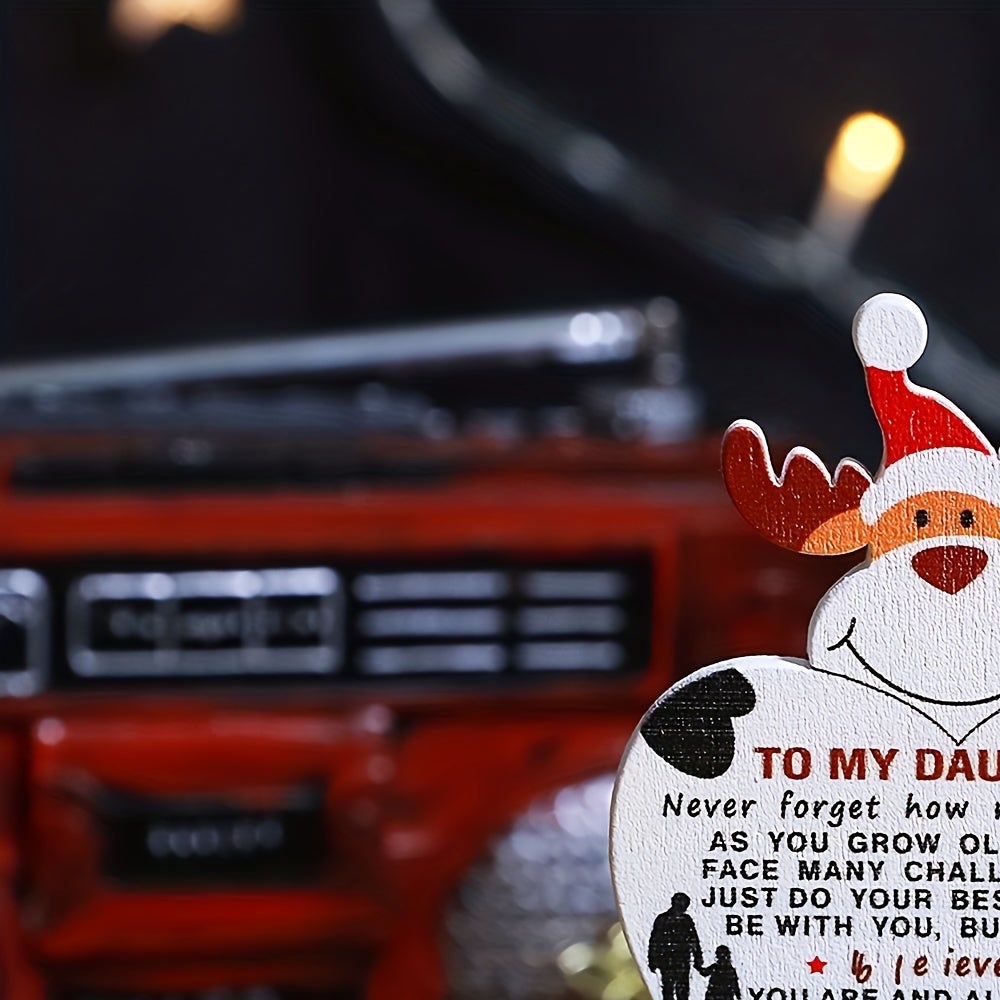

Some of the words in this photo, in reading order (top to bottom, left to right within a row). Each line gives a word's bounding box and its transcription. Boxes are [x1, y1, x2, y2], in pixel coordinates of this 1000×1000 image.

[755, 747, 811, 780] TO
[829, 748, 899, 780] MY
[662, 792, 756, 817] Never
[780, 789, 880, 827] forget
[905, 793, 969, 820] how
[709, 831, 748, 852] AS
[768, 832, 828, 852] YOU
[847, 832, 941, 854] GROW
[702, 859, 780, 880] FACE
[798, 860, 885, 881] MANY
[701, 887, 778, 908] JUST
[789, 888, 831, 909] DO
[850, 888, 932, 909] YOUR
[726, 915, 763, 936] BE
[774, 915, 853, 936] WITH
[872, 916, 941, 941] YOU,
